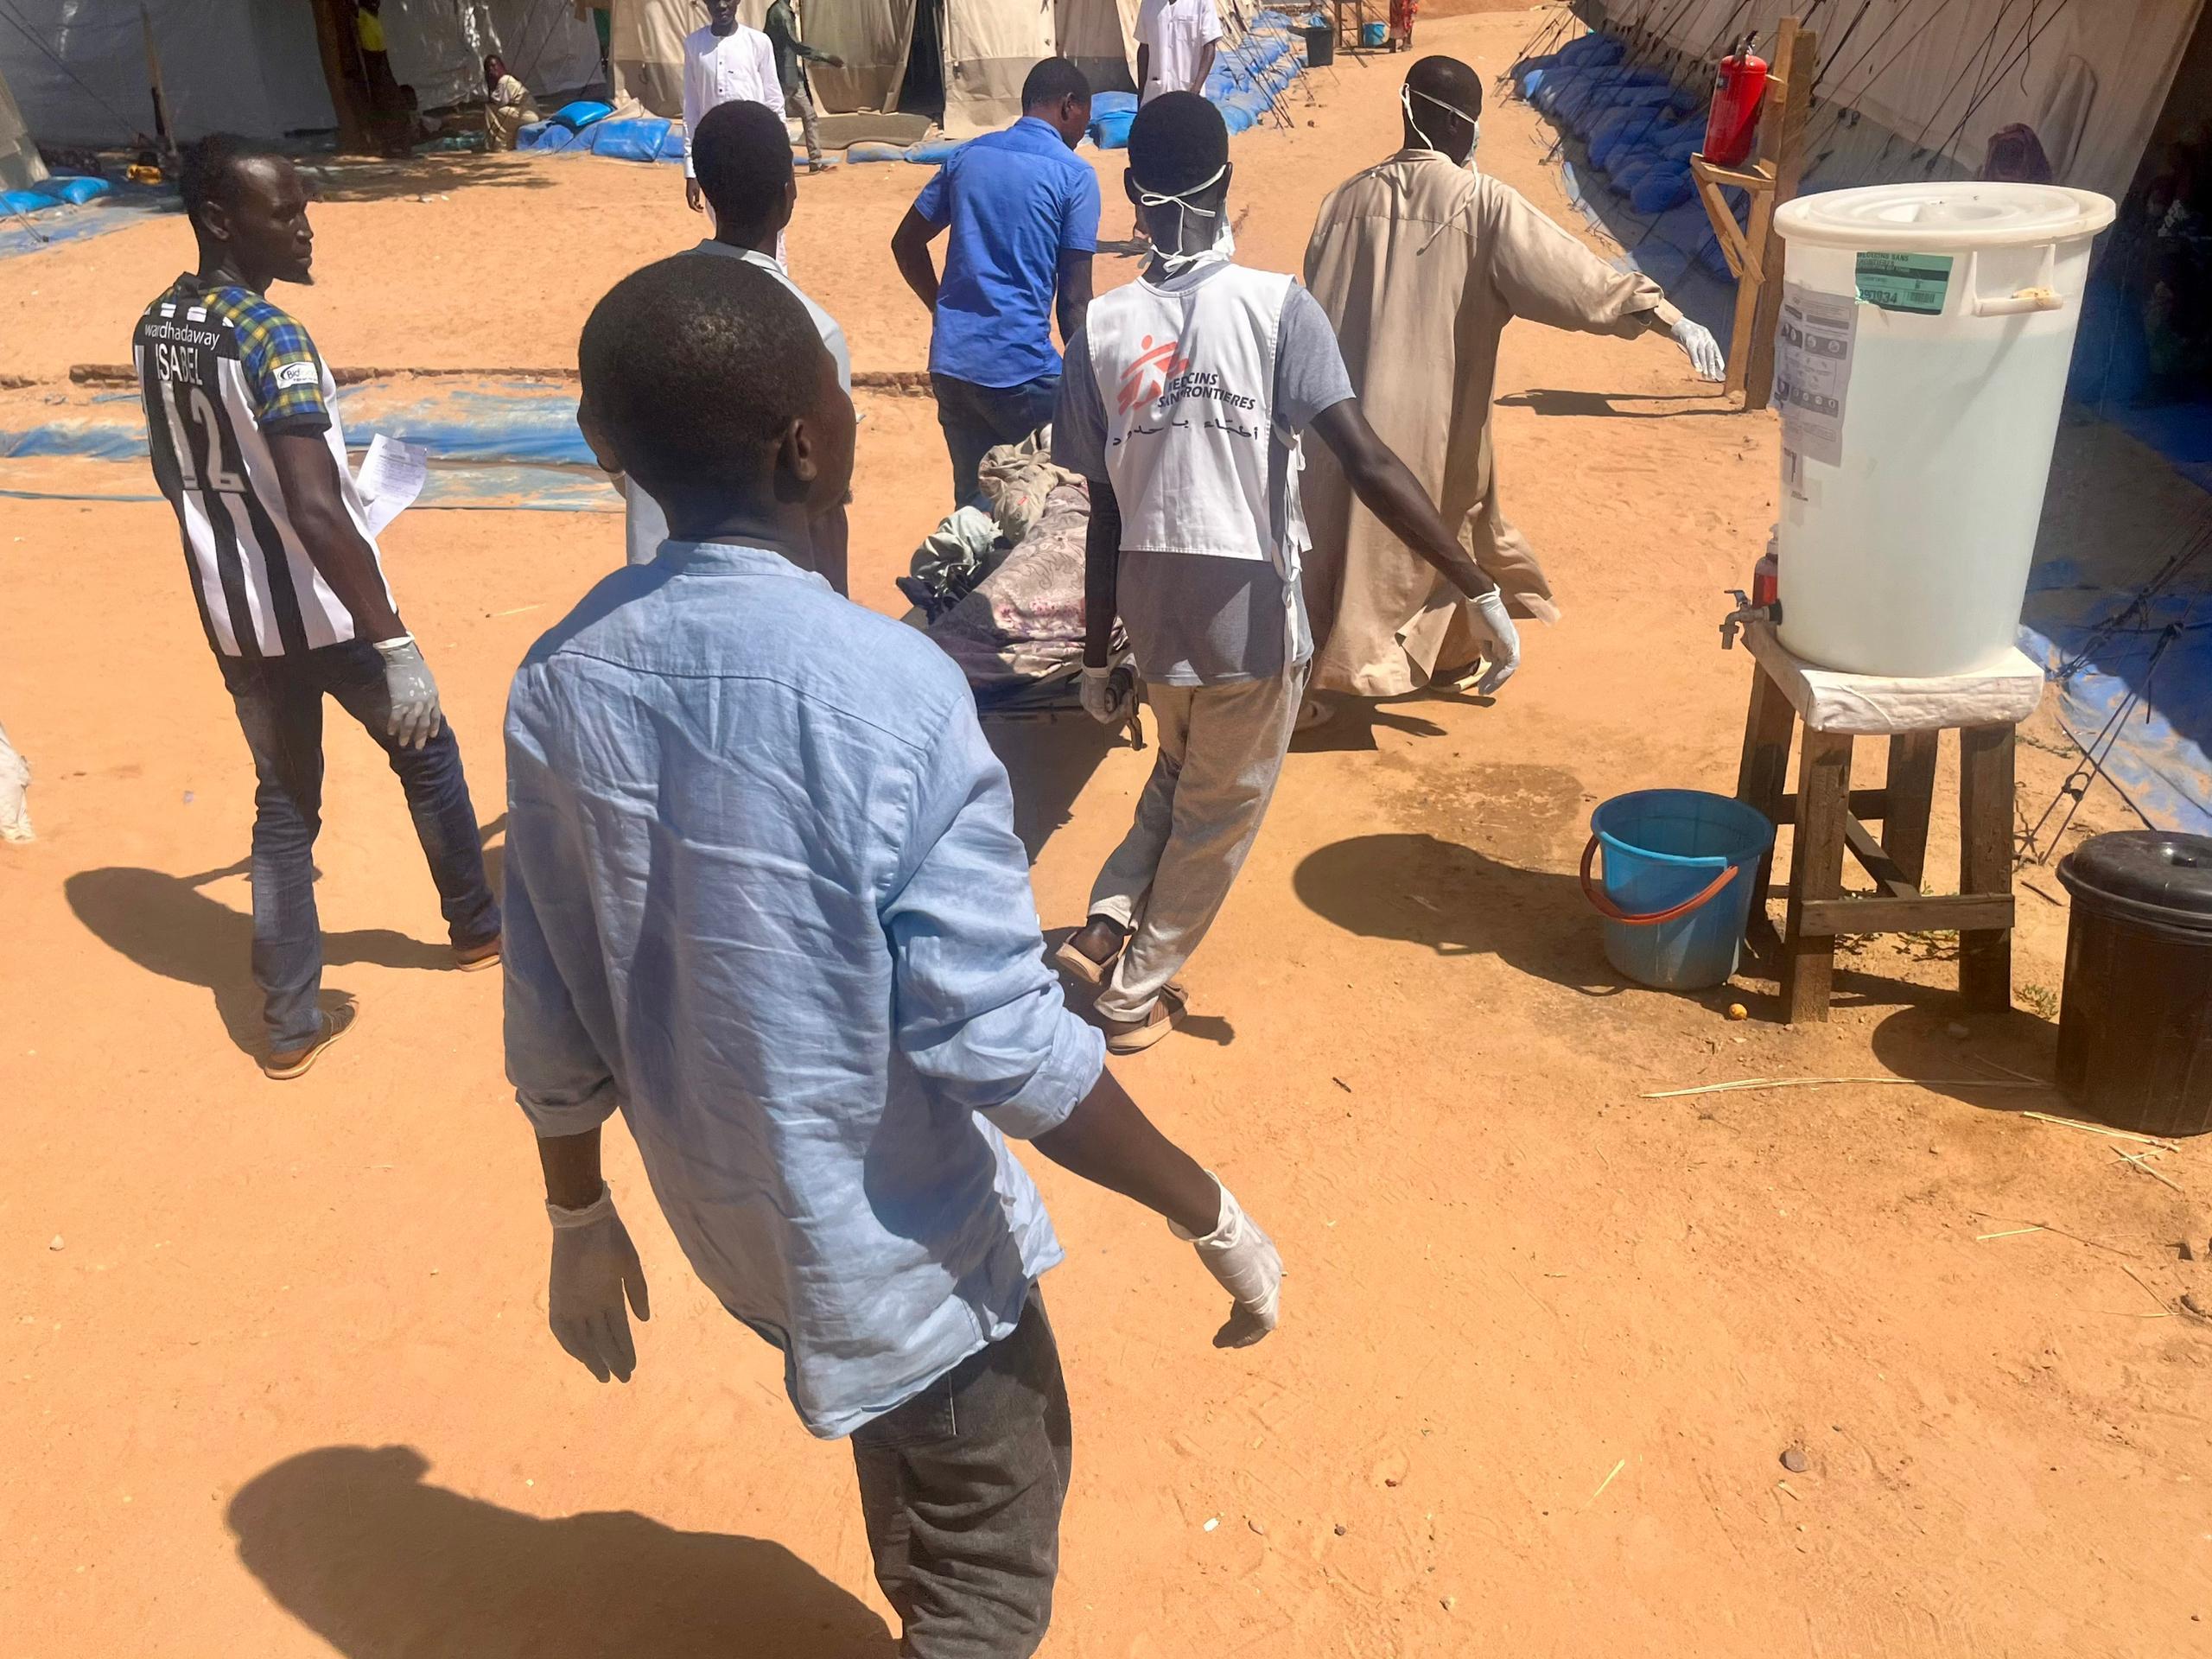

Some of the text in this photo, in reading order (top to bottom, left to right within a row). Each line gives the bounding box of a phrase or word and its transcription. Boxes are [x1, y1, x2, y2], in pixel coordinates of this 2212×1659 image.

[145, 321, 220, 351] wardhadaway
[156, 343, 203, 385] ISABEL
[1181, 386, 1255, 410] RONTIERES
[159, 379, 247, 493] 12
